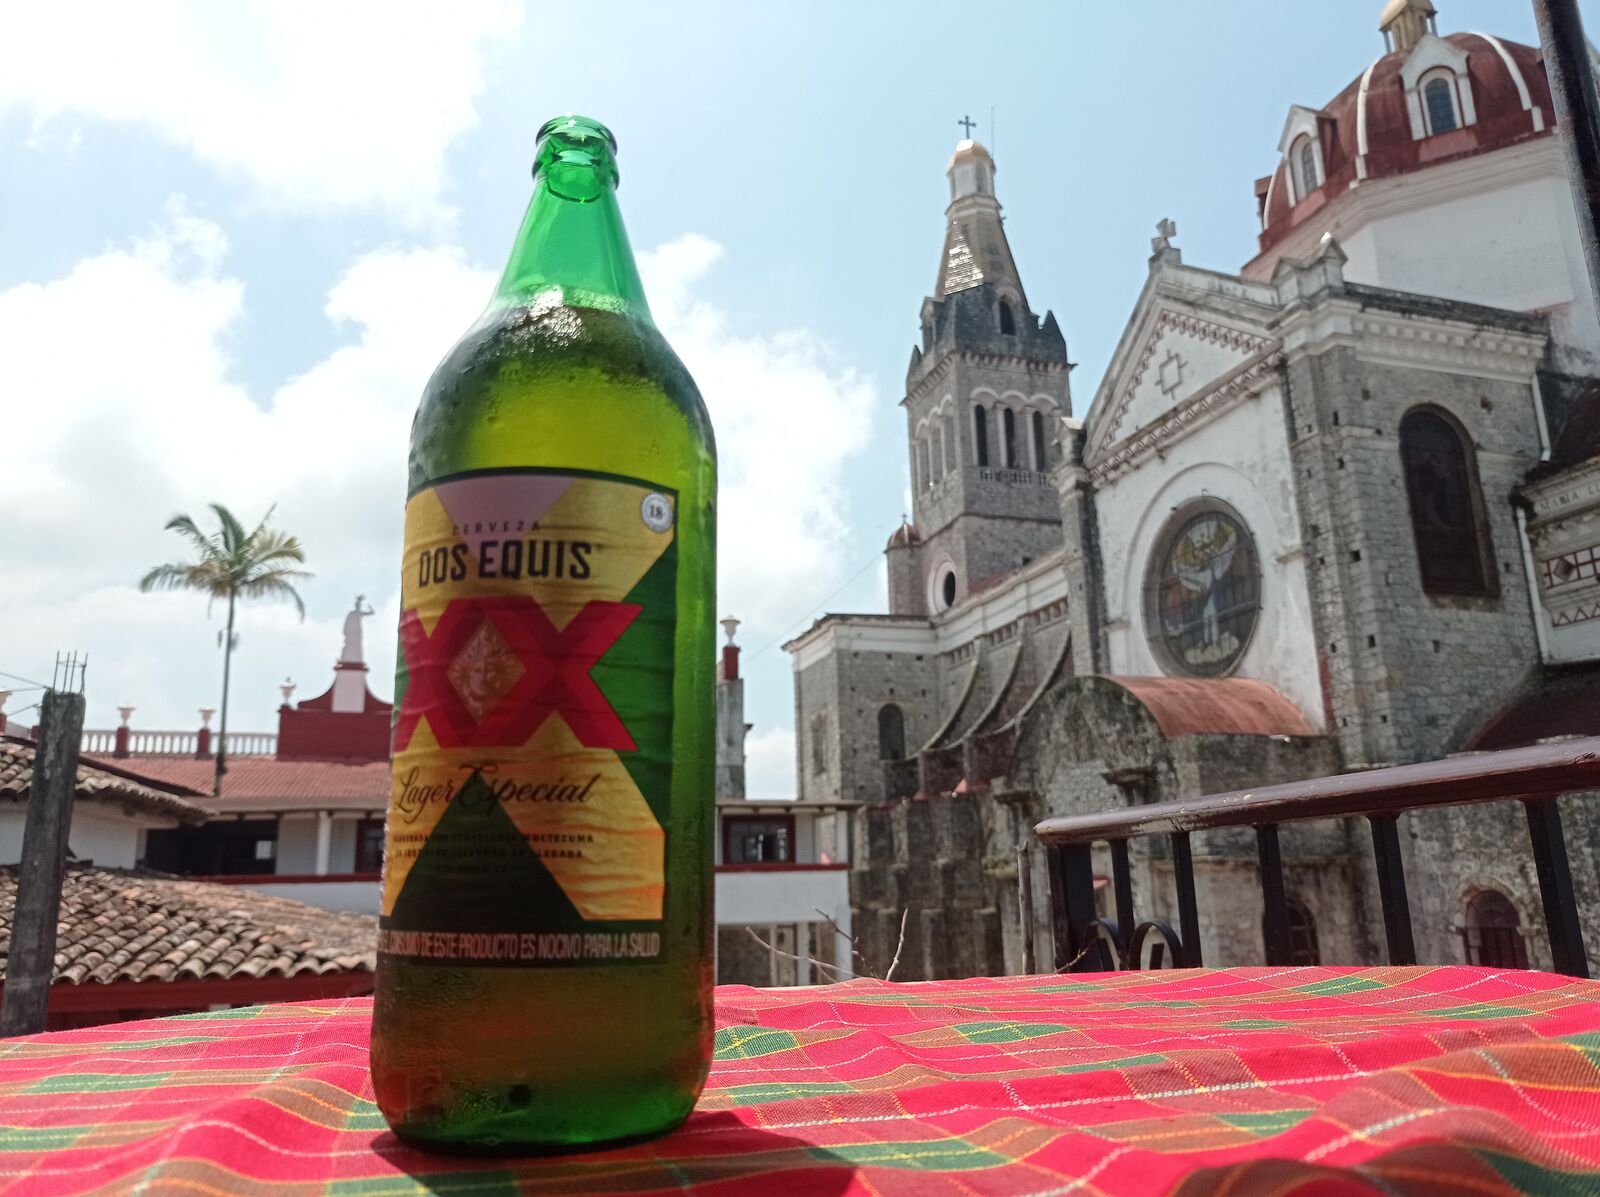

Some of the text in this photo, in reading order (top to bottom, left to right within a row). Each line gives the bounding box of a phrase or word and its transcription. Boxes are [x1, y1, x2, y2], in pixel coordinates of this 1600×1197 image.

[452, 520, 541, 537] CERVEZA
[418, 539, 592, 589] DOS EQUIS
[393, 763, 602, 825] Lager Especial
[459, 932, 518, 959] PRODUCTO
[520, 932, 536, 959] ES
[538, 932, 581, 959] NOCIVO
[583, 932, 612, 959] PARA
[614, 932, 627, 958] LA
[629, 931, 660, 958] SALUD
